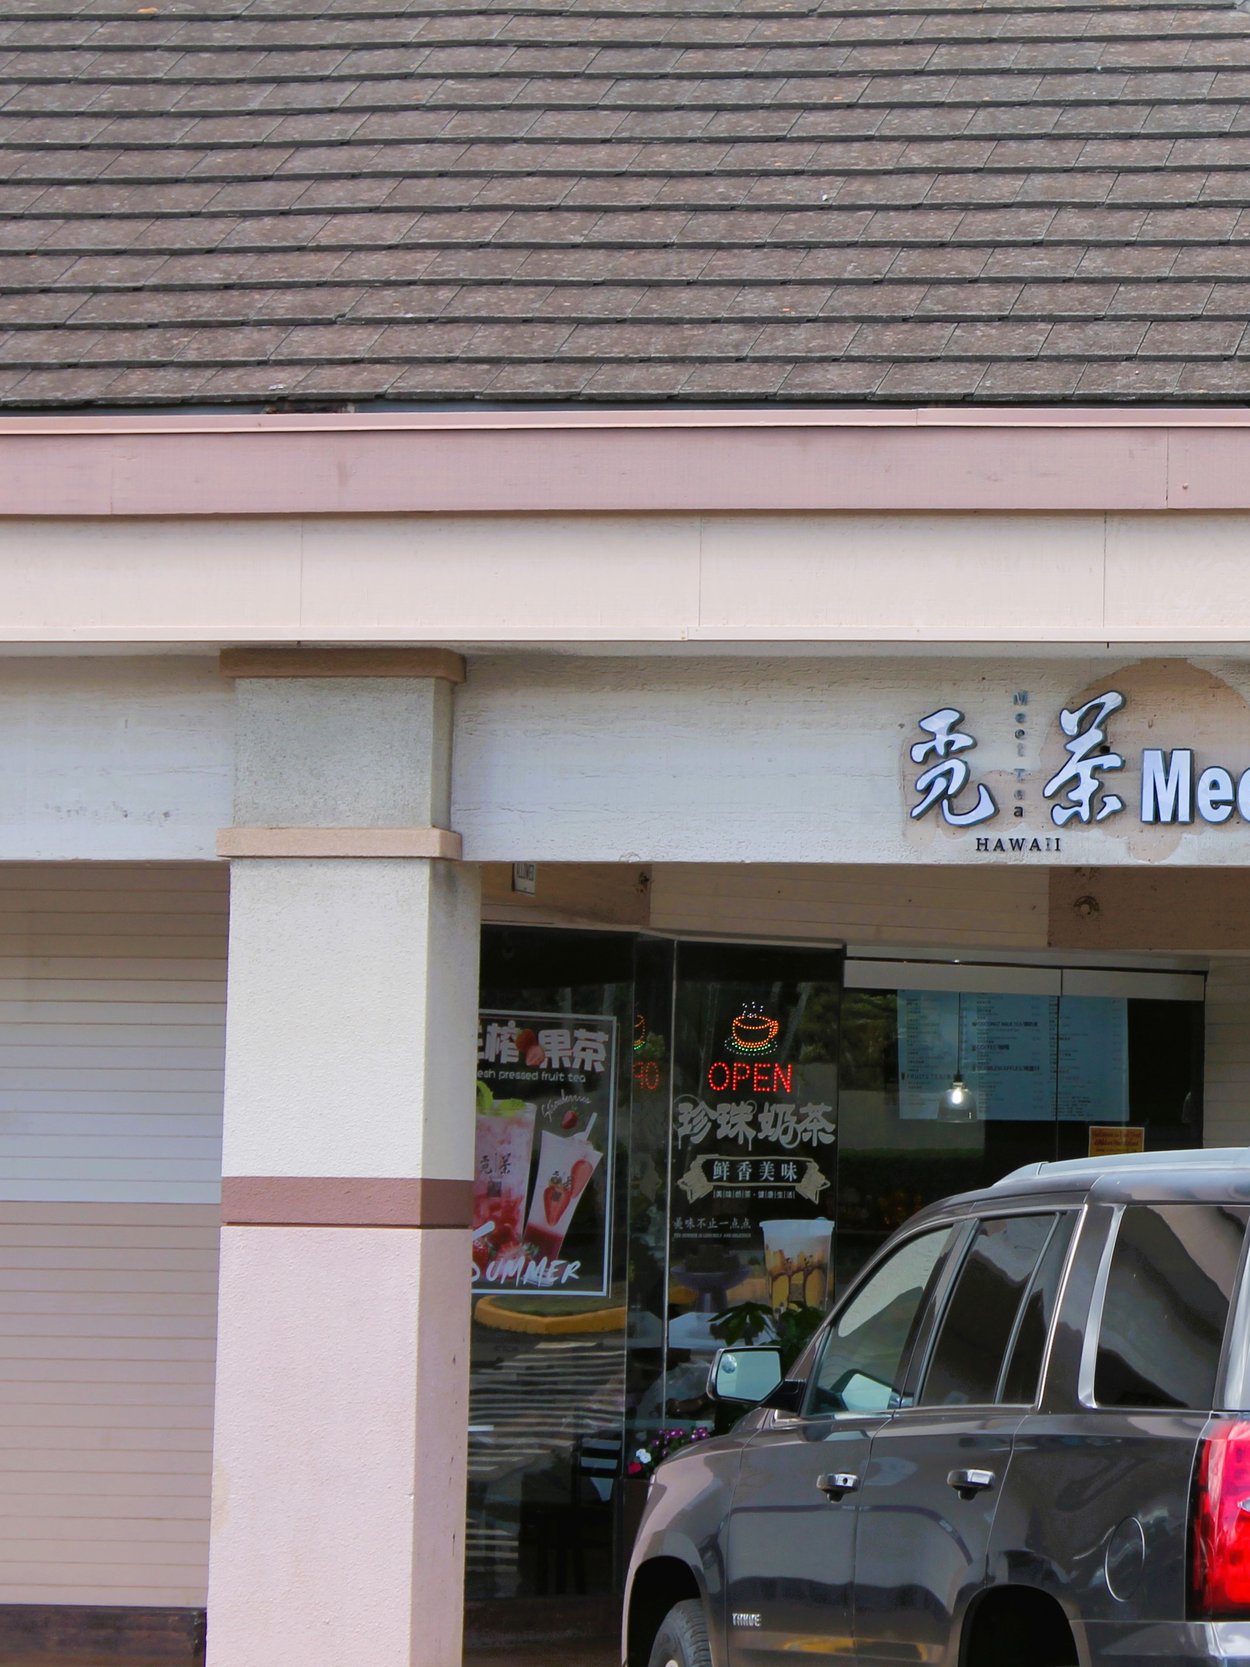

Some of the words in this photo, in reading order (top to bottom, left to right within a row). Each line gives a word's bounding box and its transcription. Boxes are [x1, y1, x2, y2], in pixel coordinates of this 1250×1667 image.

[975, 837, 1062, 852] HAWAII
[477, 1069, 496, 1079] esh
[498, 1070, 539, 1081] pressed
[541, 1071, 565, 1081] fruit
[567, 1073, 586, 1083] tea
[707, 1061, 793, 1093] OPEN
[677, 1101, 836, 1150] 珍珠奶茶
[713, 1161, 798, 1182] 鲜香美味
